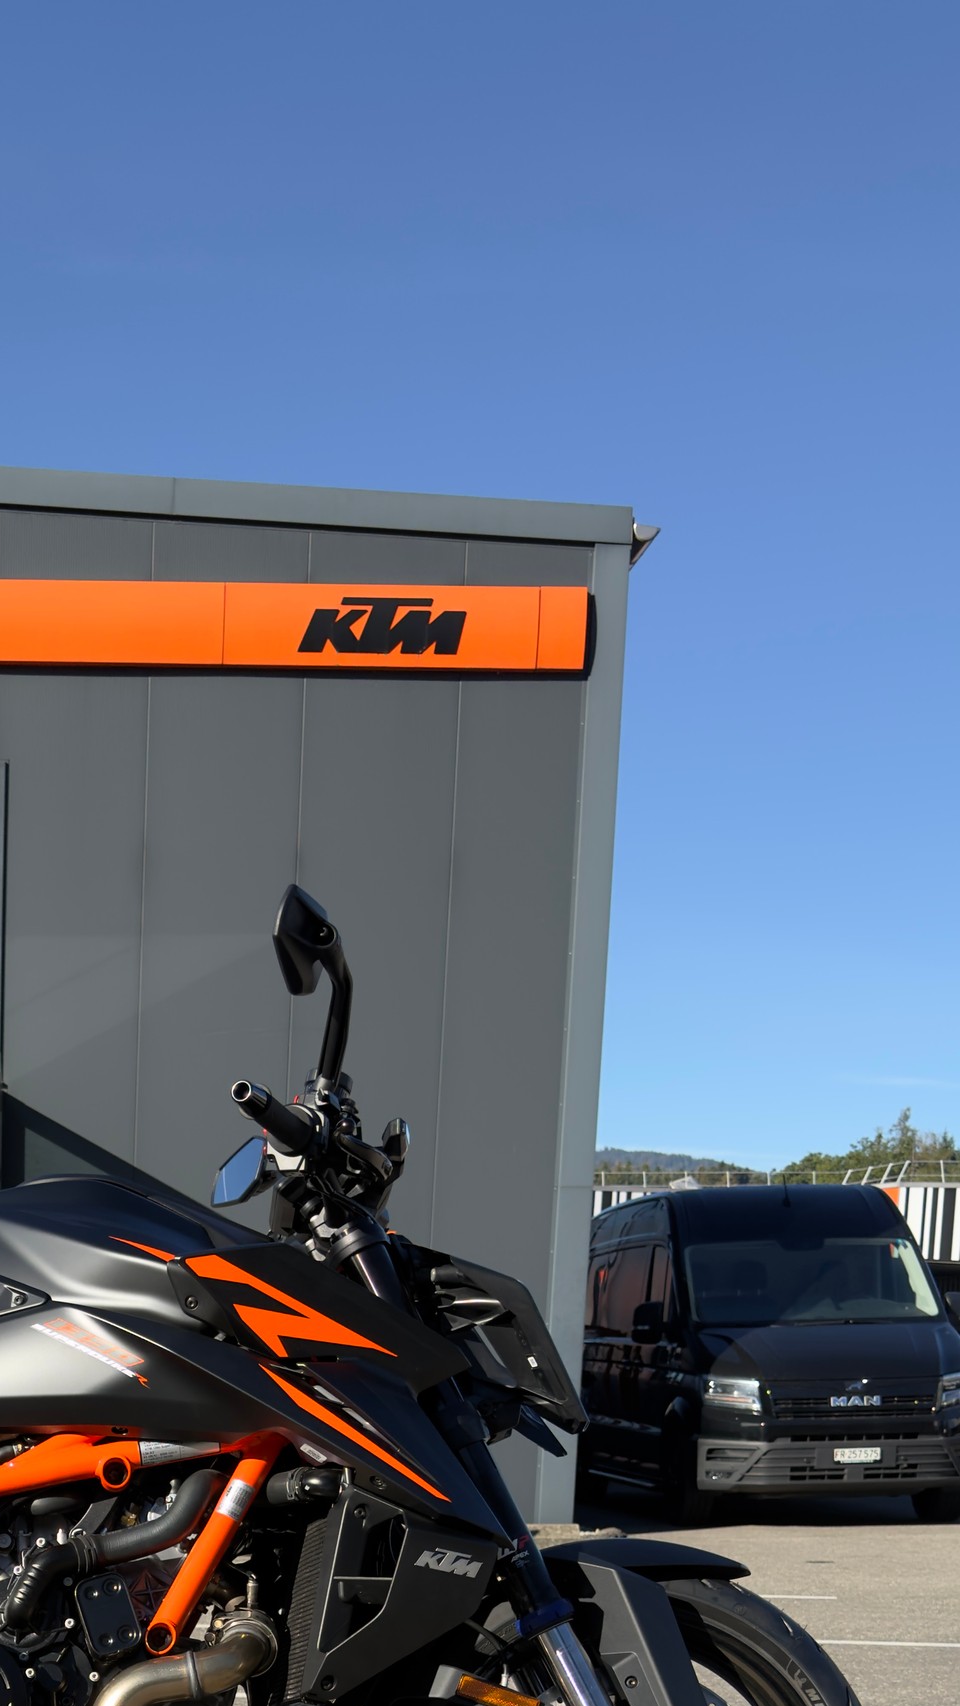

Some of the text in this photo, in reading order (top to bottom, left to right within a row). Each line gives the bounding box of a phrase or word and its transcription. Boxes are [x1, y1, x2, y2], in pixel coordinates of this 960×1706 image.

[297, 597, 467, 655] KTM
[830, 1395, 881, 1407] MAN
[414, 1547, 483, 1578] KTM
